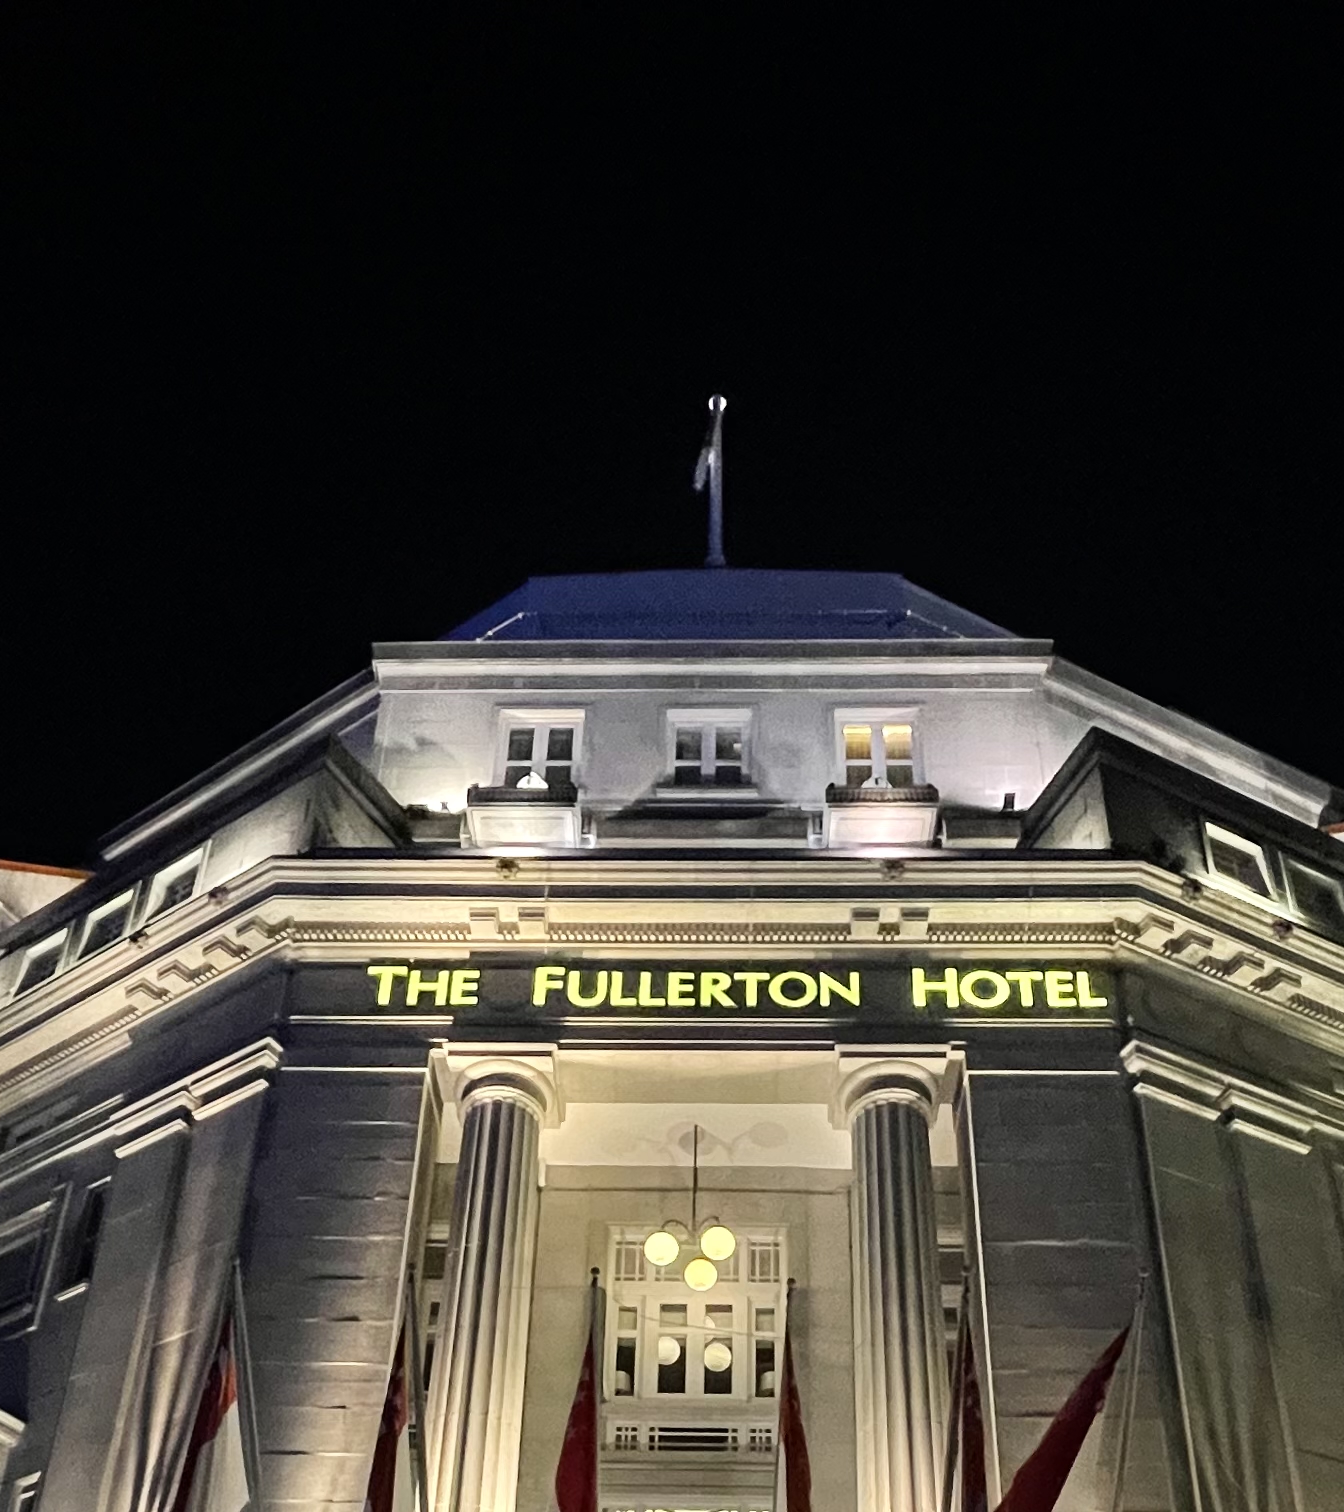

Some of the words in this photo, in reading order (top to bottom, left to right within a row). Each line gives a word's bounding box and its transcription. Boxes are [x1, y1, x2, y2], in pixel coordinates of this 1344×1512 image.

[367, 965, 481, 1007] THE
[532, 966, 861, 1008] FULLERTON
[911, 967, 1109, 1009] HOTEL
